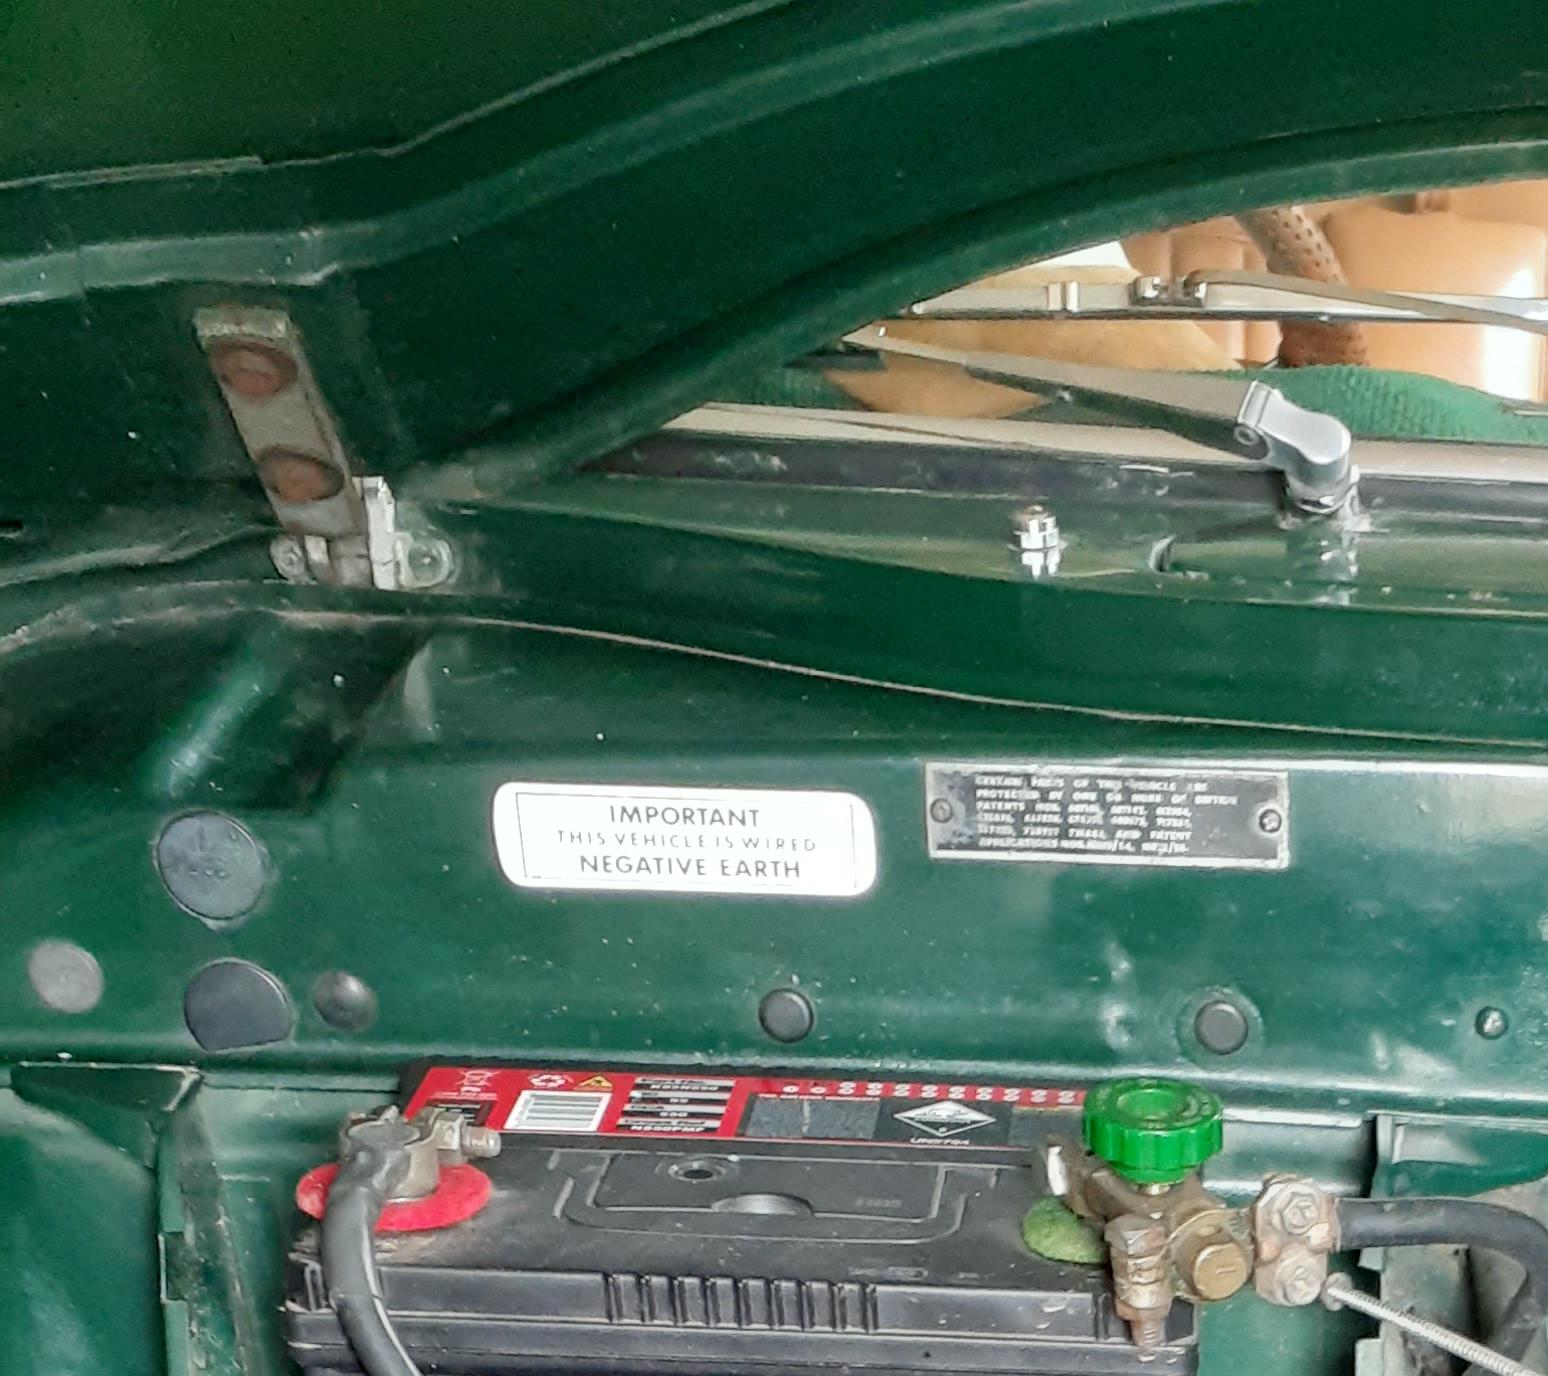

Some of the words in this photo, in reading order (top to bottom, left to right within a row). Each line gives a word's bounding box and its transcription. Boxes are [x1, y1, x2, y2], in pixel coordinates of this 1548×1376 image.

[609, 804, 760, 828] IMPORTANT
[558, 829, 606, 846] THIS
[614, 831, 706, 849] VEHICLE
[715, 835, 734, 849] IS
[742, 837, 817, 852] WIRED
[579, 854, 708, 877] NEGATIVE
[720, 858, 801, 879] EARTH
